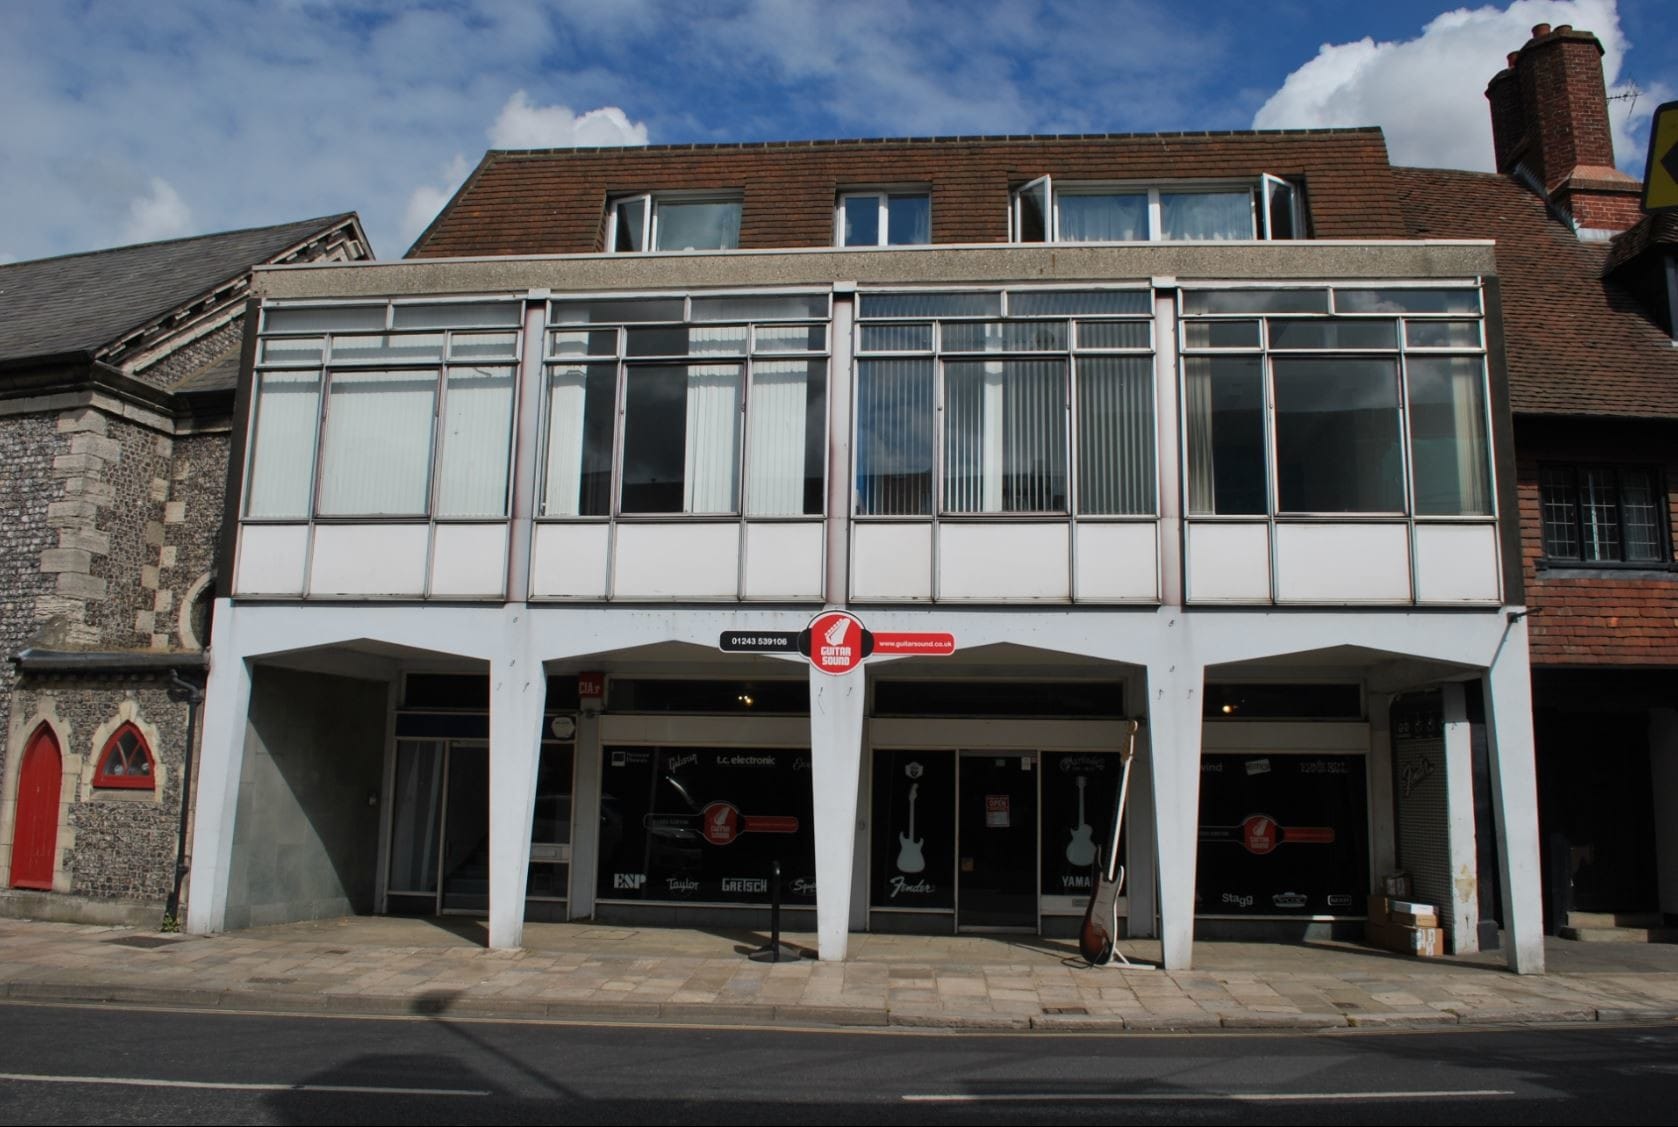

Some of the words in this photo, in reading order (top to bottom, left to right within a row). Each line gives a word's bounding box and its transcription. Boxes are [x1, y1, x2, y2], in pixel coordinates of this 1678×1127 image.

[731, 637, 756, 646] 01243
[757, 638, 788, 646] 539106
[879, 640, 952, 649] www.guitarsound.co.uk
[820, 646, 852, 656] GUITAR
[822, 656, 850, 666] SOUND
[731, 754, 777, 766] electronic
[613, 873, 647, 889] ESP
[665, 877, 701, 893] Taylor
[721, 877, 768, 892] GRETSCH
[890, 876, 936, 898] Fender
[1062, 876, 1091, 888] YAMA
[1222, 893, 1254, 908] Stagg
